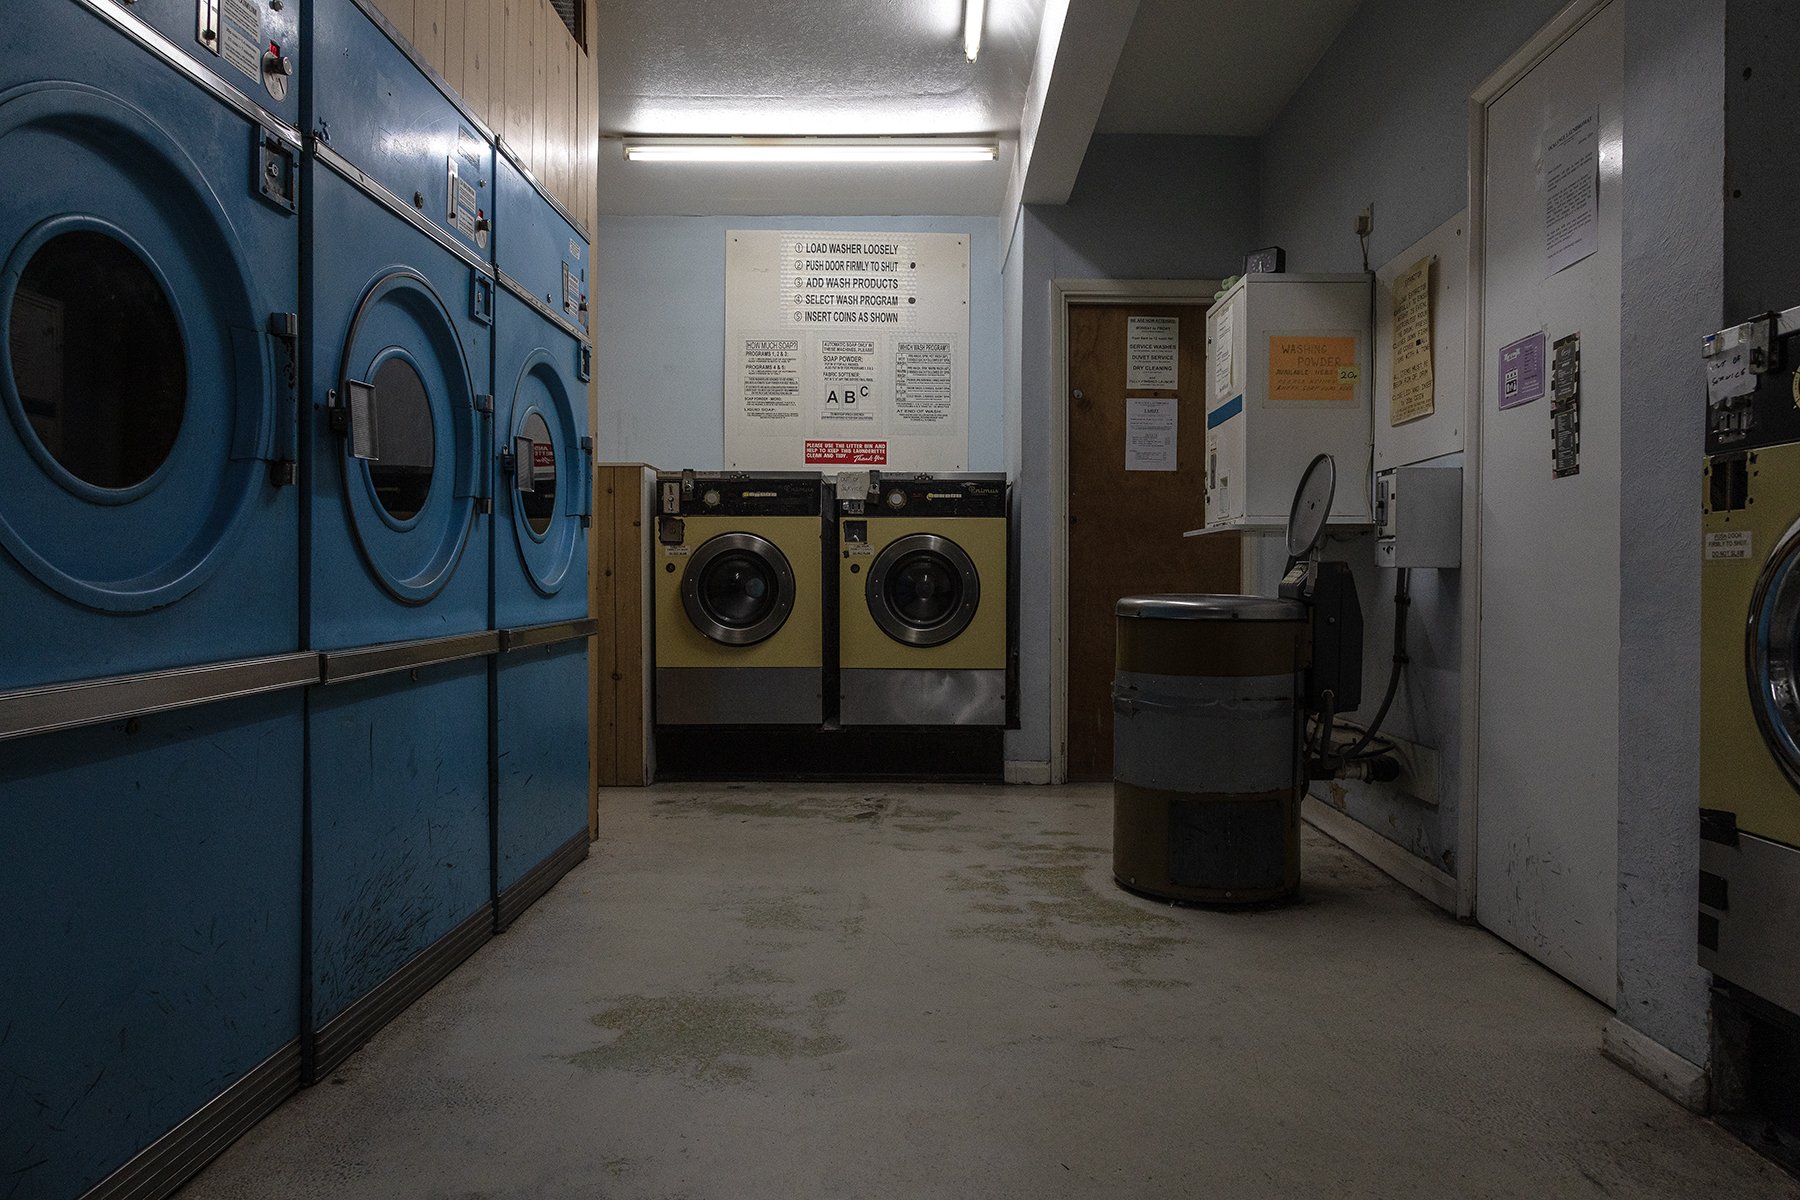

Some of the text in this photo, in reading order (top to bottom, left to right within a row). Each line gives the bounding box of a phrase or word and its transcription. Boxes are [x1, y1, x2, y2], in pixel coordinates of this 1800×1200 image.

[806, 243, 827, 253] LOAD
[829, 244, 862, 254] WASHER
[864, 244, 898, 254] LOOSELY
[806, 260, 824, 270] PUSH
[826, 261, 844, 270] DOOR
[846, 262, 869, 271] FIRMLY
[870, 262, 880, 271] TO
[881, 262, 898, 272] SHUT
[806, 278, 824, 288] ADD
[826, 278, 850, 288] WASH
[852, 278, 898, 288] PRODUCTS
[805, 294, 834, 304] SELECT
[836, 295, 858, 305] WASH
[860, 296, 898, 305] PROGRAM
[804, 312, 832, 322] INSERT
[833, 312, 856, 322] COINS
[858, 312, 868, 322] AS
[870, 313, 898, 322] SHOWN
[746, 342, 760, 350] HOW
[761, 342, 777, 350] MUCH
[1282, 344, 1327, 354] WASHING
[1298, 357, 1342, 367] POWDER
[827, 386, 868, 403] A B C
[854, 455, 873, 463] Thank
